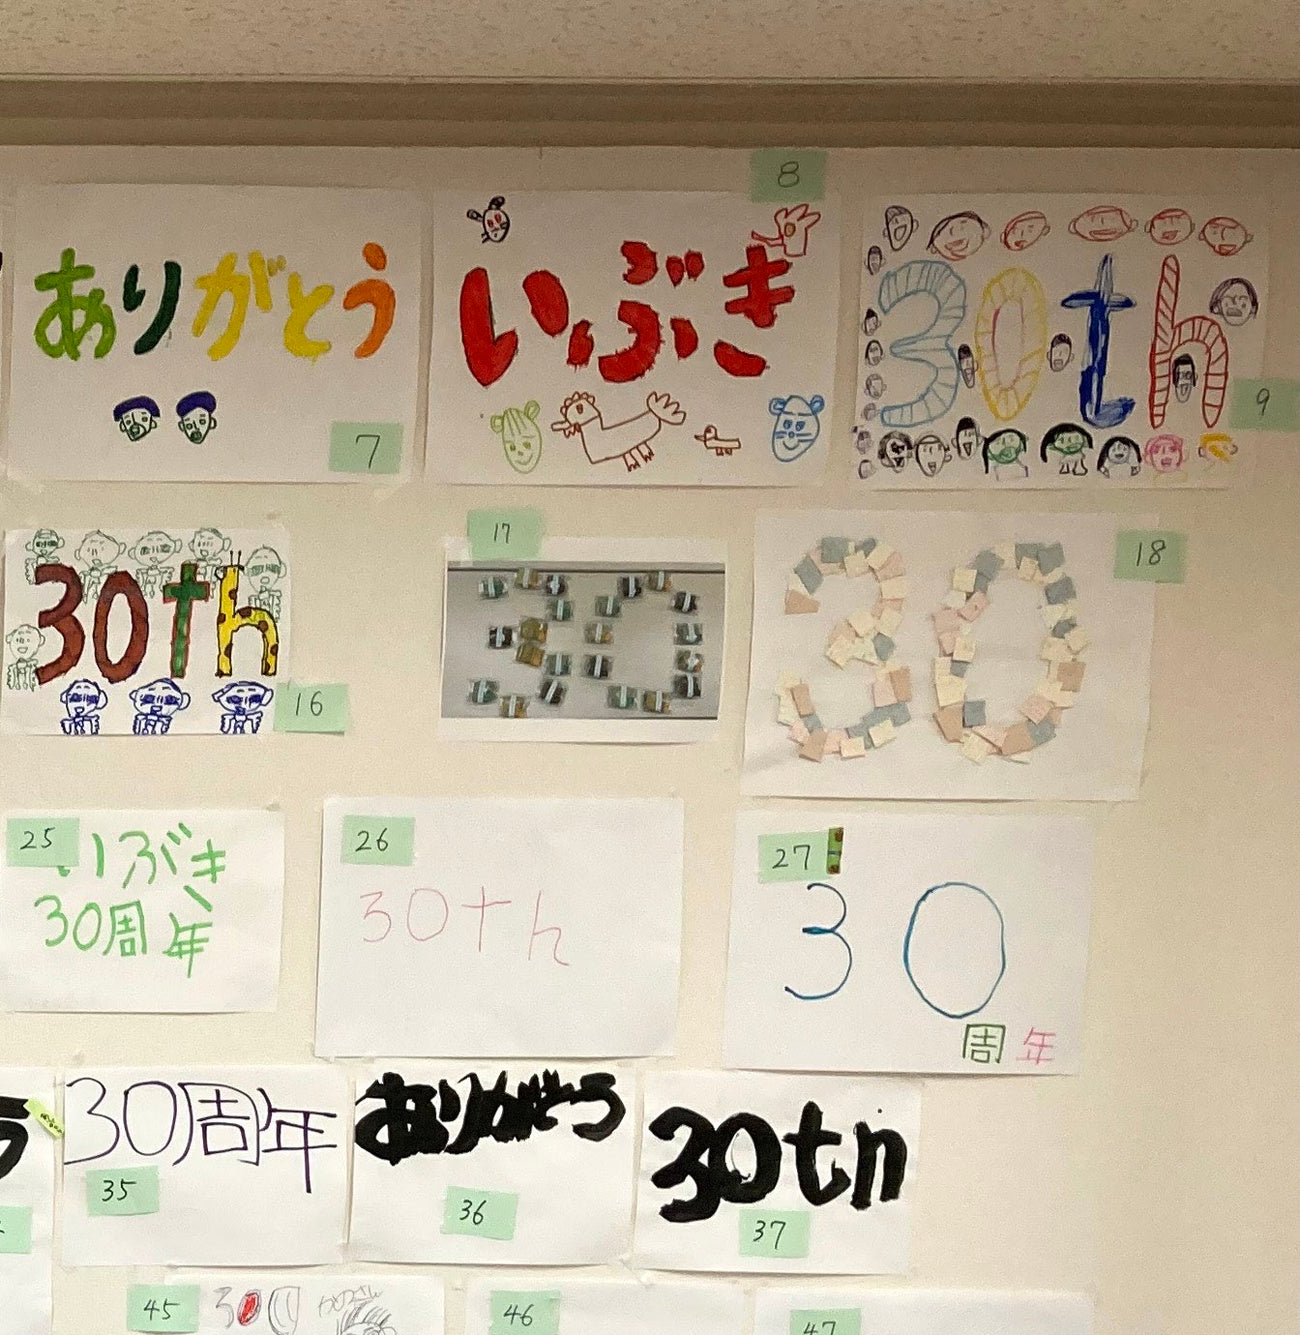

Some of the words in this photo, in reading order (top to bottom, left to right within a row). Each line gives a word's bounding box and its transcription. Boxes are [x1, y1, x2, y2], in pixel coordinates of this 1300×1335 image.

[777, 160, 800, 189] 8
[33, 242, 397, 361] ありがとう
[458, 243, 795, 386] いぶき
[877, 254, 1230, 429] 30th
[1256, 388, 1270, 416] 9
[354, 435, 381, 469] 7
[493, 522, 511, 544] 17
[1134, 538, 1164, 567] 18
[34, 555, 281, 684] 30th
[292, 691, 324, 717] 16
[19, 828, 57, 850] 25
[355, 826, 391, 853] 26
[772, 843, 812, 870] 27
[33, 894, 213, 978] 30周年
[359, 884, 570, 966] 30th
[784, 881, 1006, 1019] 30
[960, 1022, 1057, 1066] 周年
[62, 1077, 338, 1194] 30周年
[102, 1179, 135, 1200] 35
[459, 1200, 484, 1225] 36
[753, 1220, 786, 1249] 37
[144, 1298, 180, 1320] 45
[504, 1303, 535, 1326] 46
